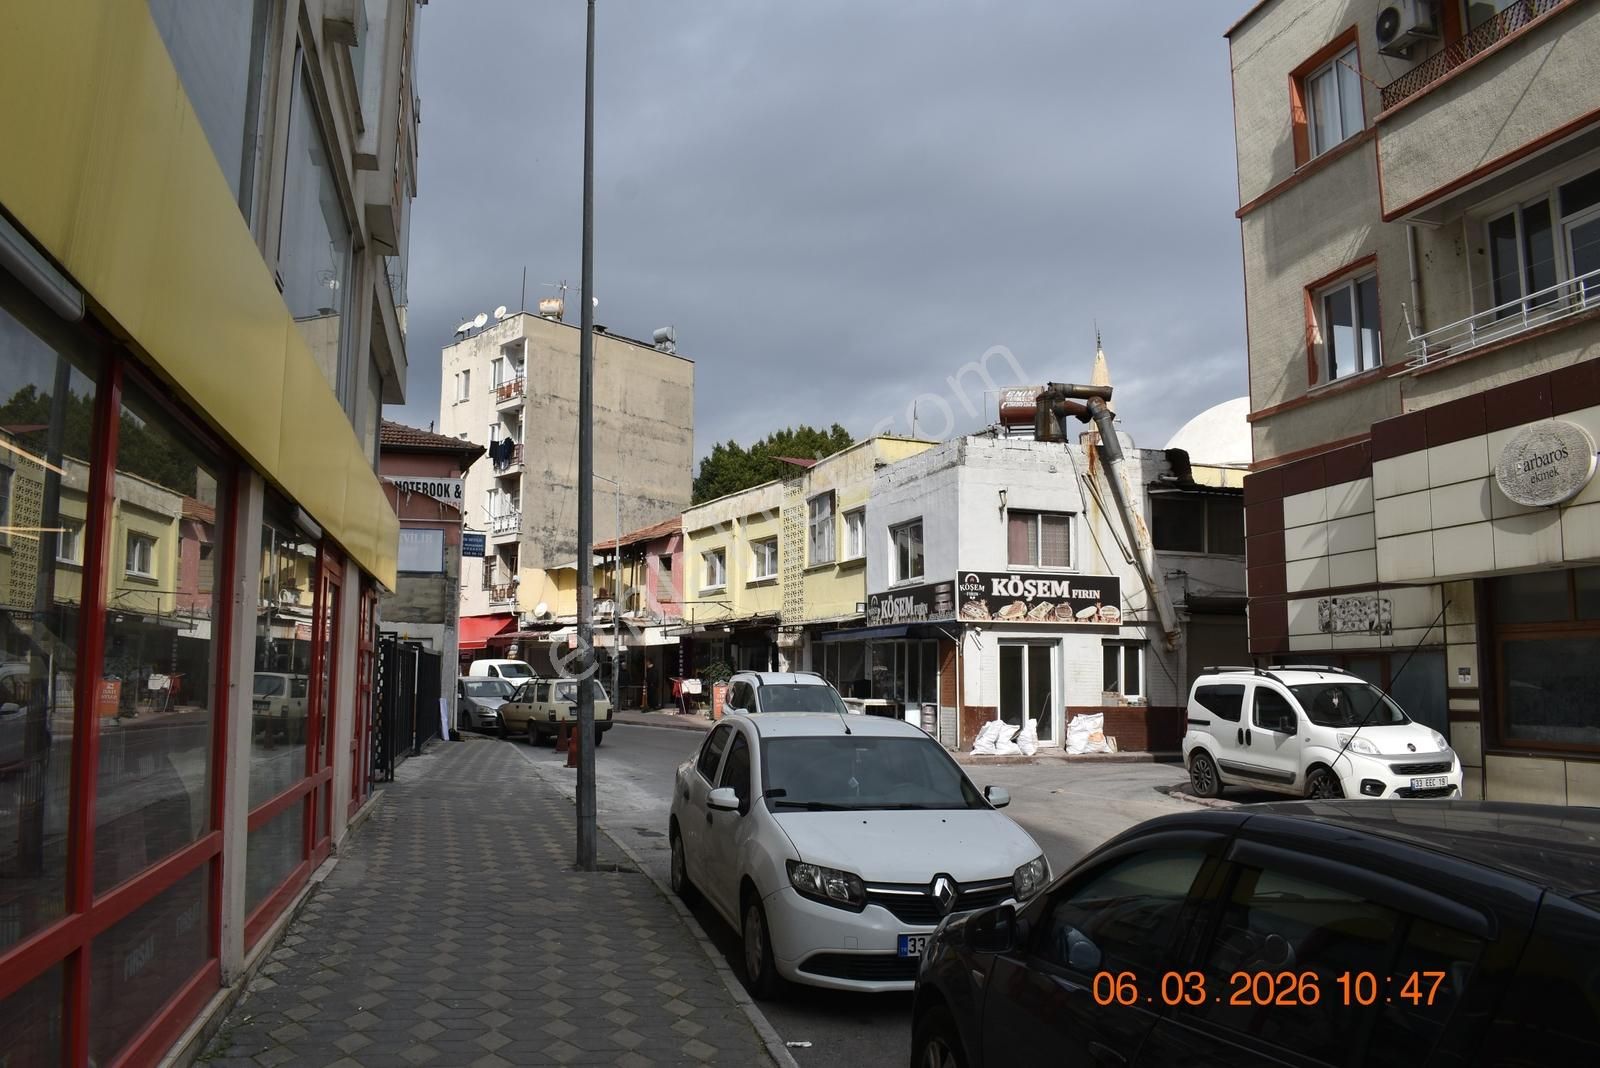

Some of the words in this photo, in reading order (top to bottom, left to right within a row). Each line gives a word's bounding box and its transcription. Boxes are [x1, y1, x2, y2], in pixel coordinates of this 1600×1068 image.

[1530, 465, 1560, 484] ekmek
[454, 484, 462, 499] &
[991, 575, 1070, 602] KÖŞEM
[1072, 589, 1101, 599] FIRIN
